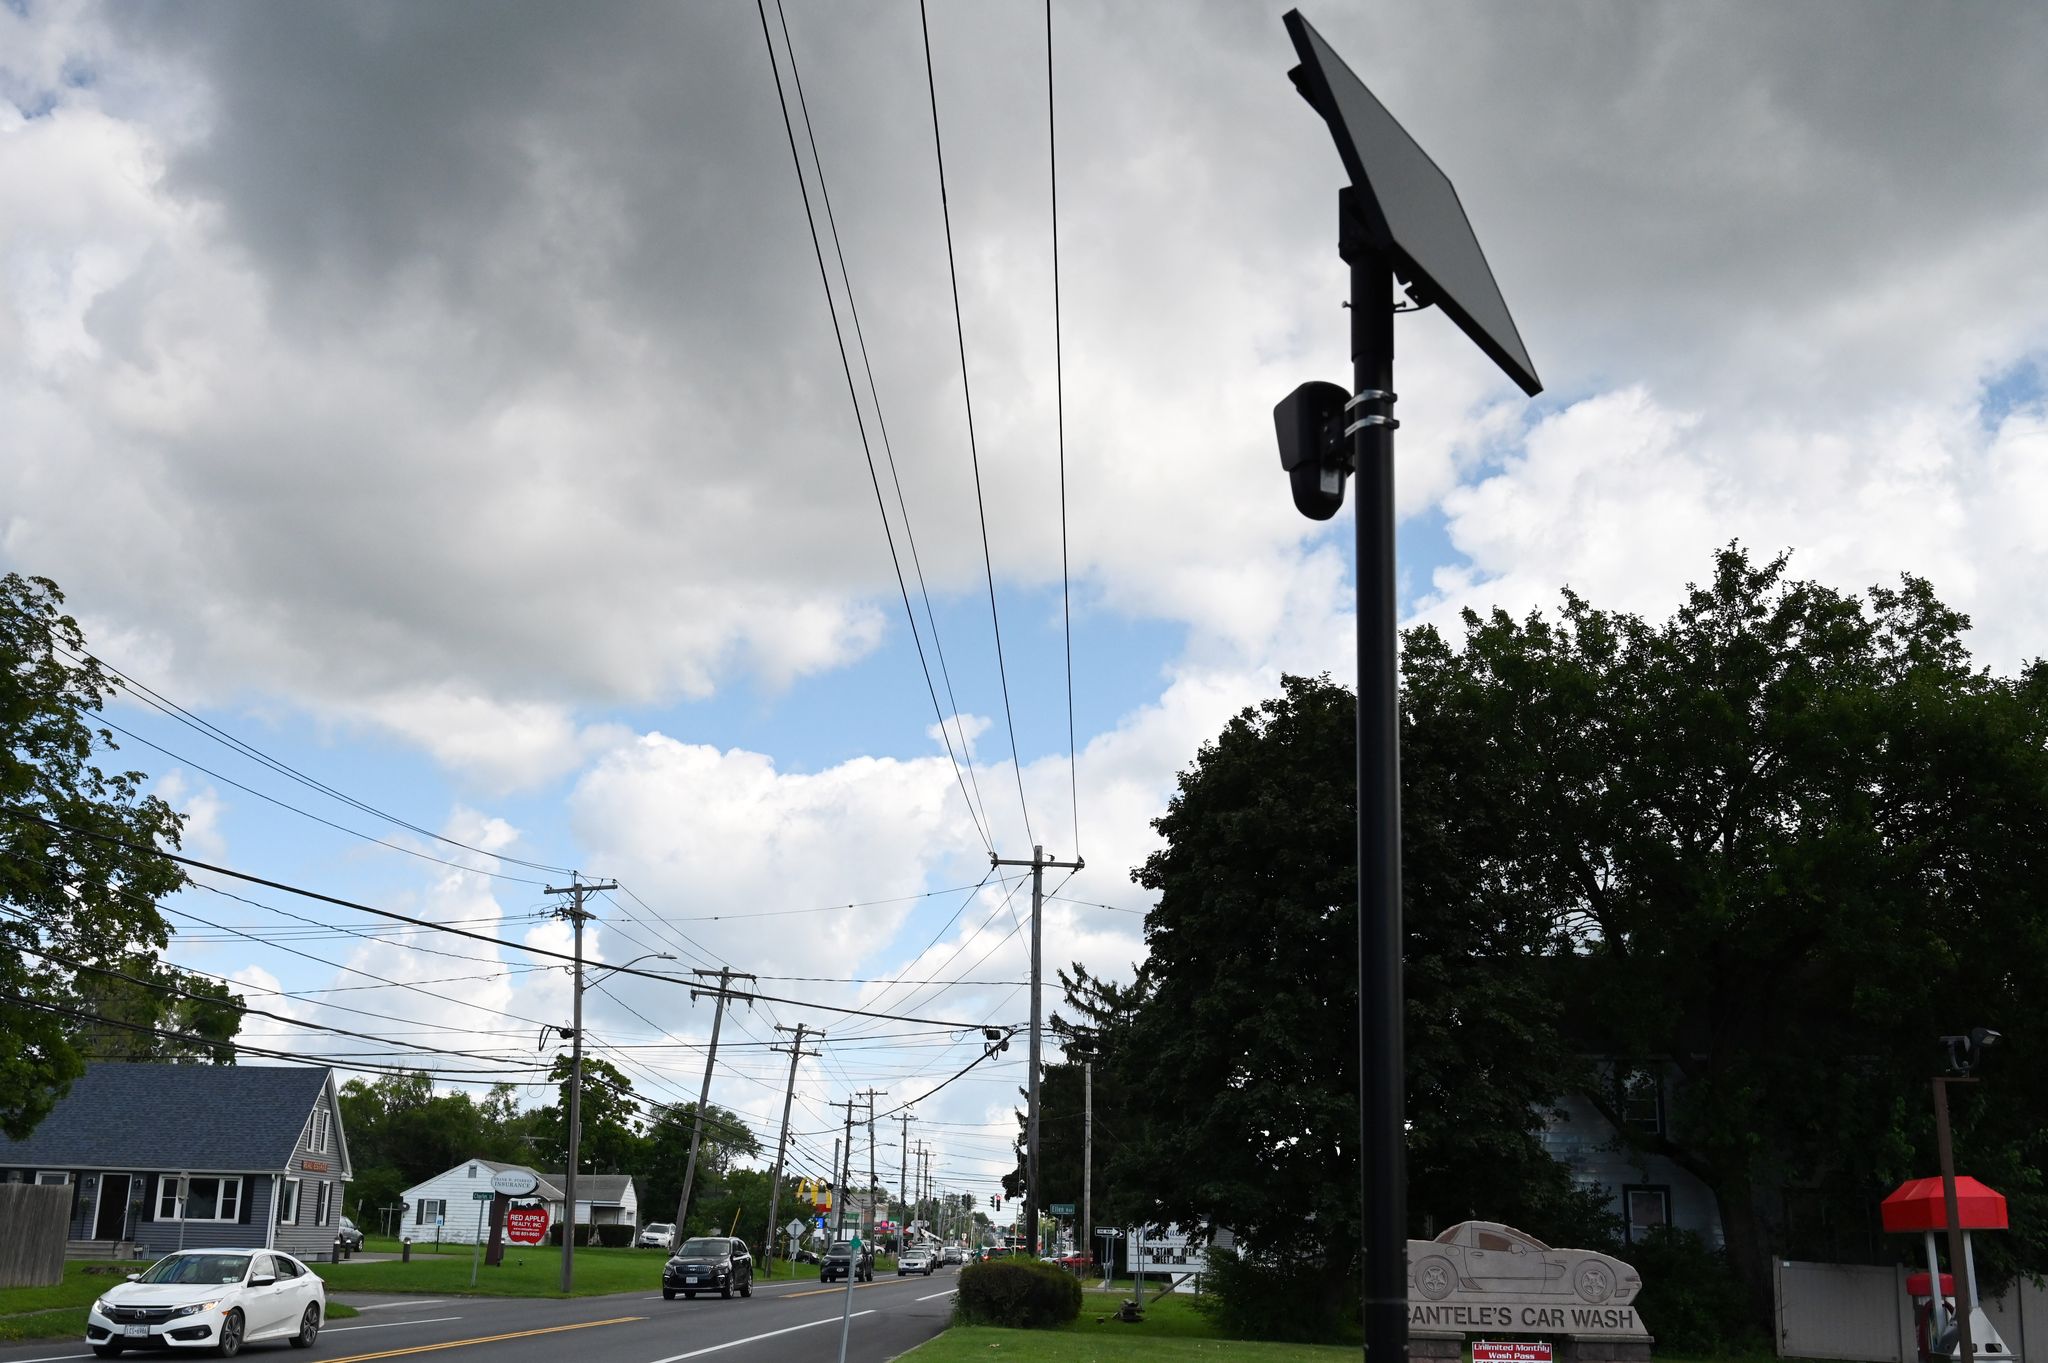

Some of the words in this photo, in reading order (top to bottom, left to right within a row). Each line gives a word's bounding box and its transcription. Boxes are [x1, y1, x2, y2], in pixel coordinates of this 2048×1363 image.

[1156, 1247, 1173, 1256] STAND
[1152, 1256, 1170, 1264] SWEET
[1172, 1256, 1187, 1264] CORN
[1407, 1306, 1512, 1327] ANTELE'S
[1521, 1307, 1565, 1328] CAR
[1571, 1309, 1633, 1329] WASH
[1474, 1343, 1514, 1351] Unlimited
[1515, 1344, 1550, 1353] Monthly
[1514, 1352, 1536, 1360] Pass
